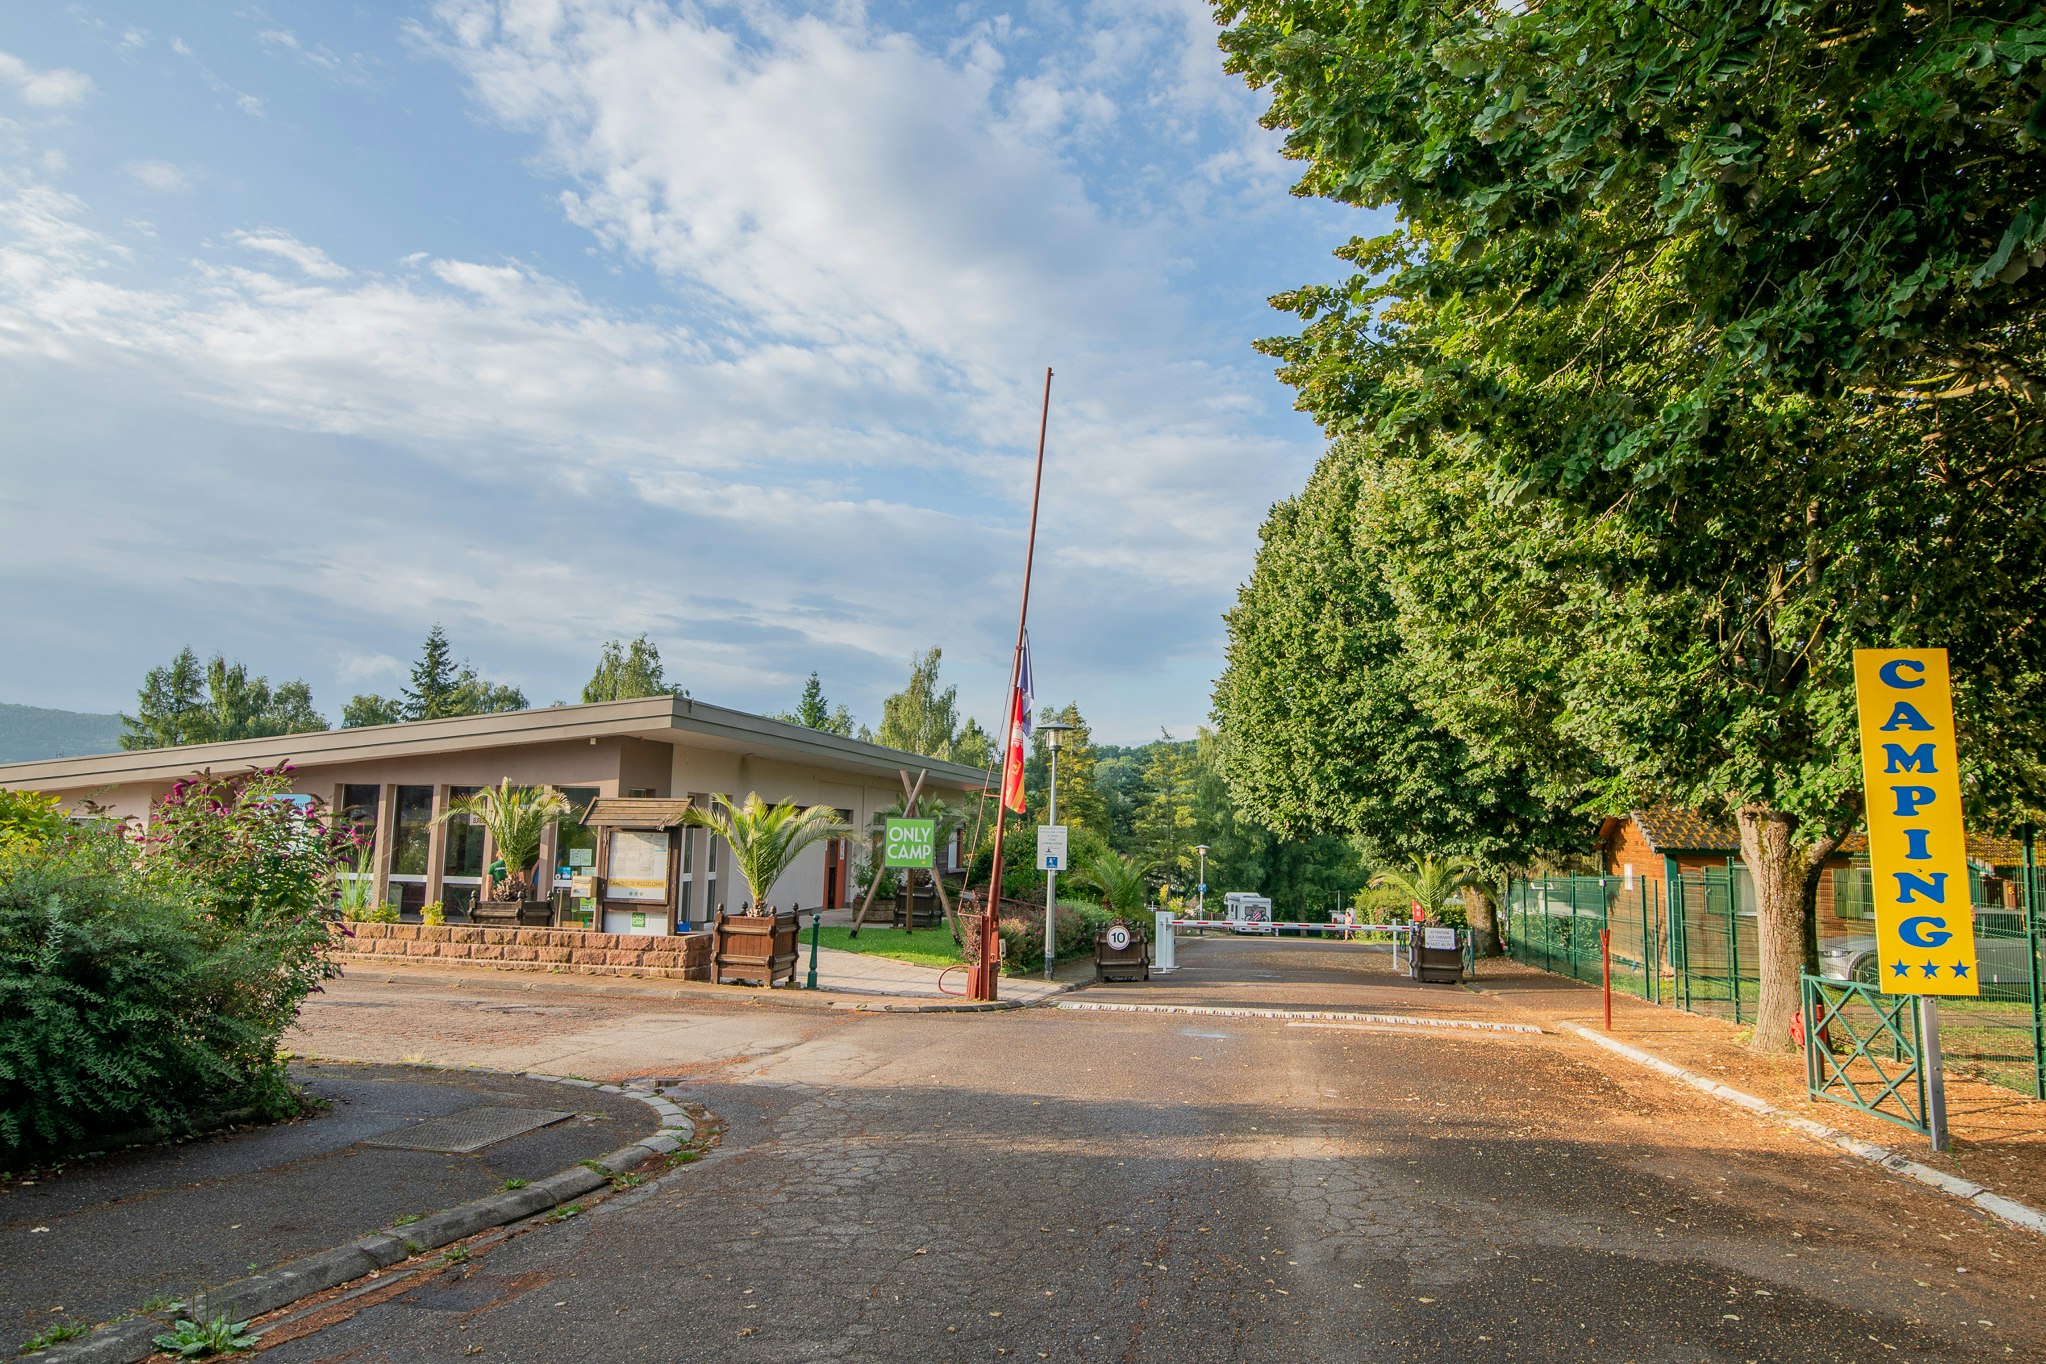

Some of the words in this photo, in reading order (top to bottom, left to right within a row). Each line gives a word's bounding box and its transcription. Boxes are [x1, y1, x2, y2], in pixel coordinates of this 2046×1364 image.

[1879, 659, 1953, 948] CAMPING
[889, 826, 931, 843] ONLY
[887, 844, 931, 860] CAMP
[1111, 932, 1126, 944] 10
